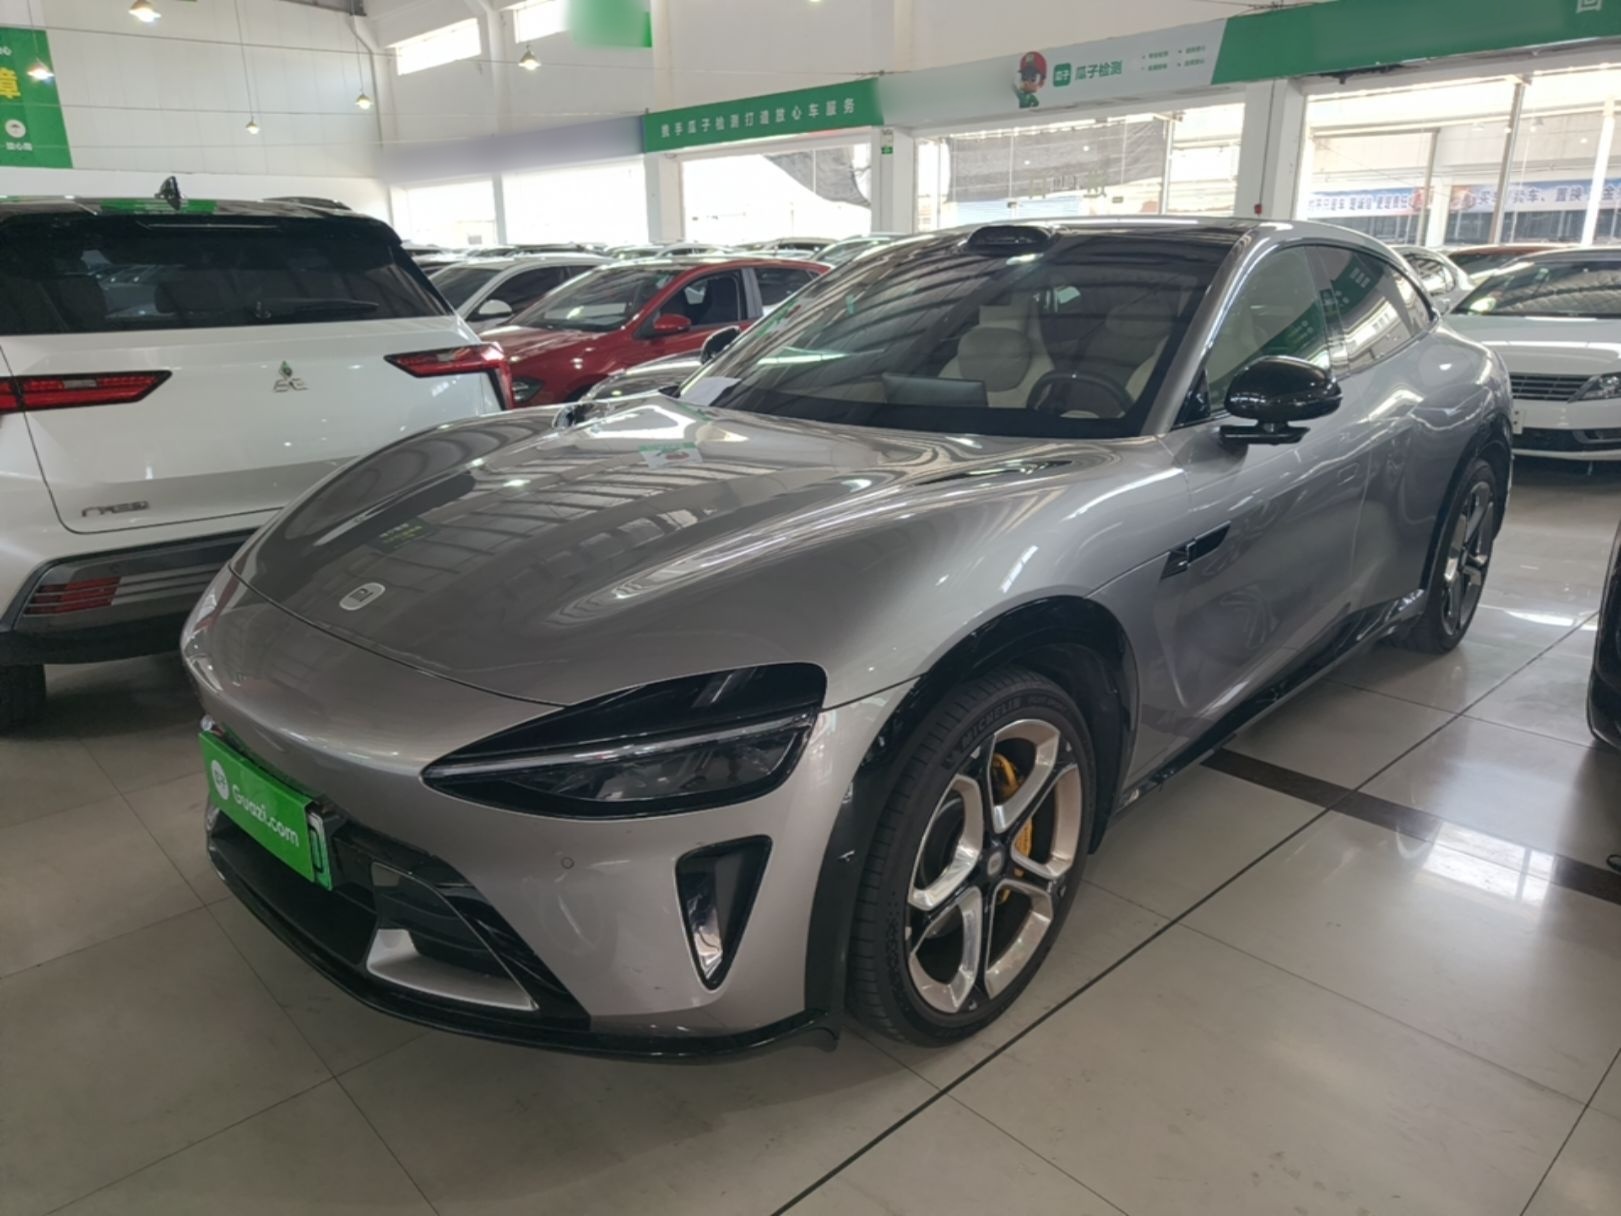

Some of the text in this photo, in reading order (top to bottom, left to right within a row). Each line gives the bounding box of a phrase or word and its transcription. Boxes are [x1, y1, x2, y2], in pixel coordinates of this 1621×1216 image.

[1075, 60, 1123, 80] 瓜子检测
[232, 784, 300, 848] Guazi.com
